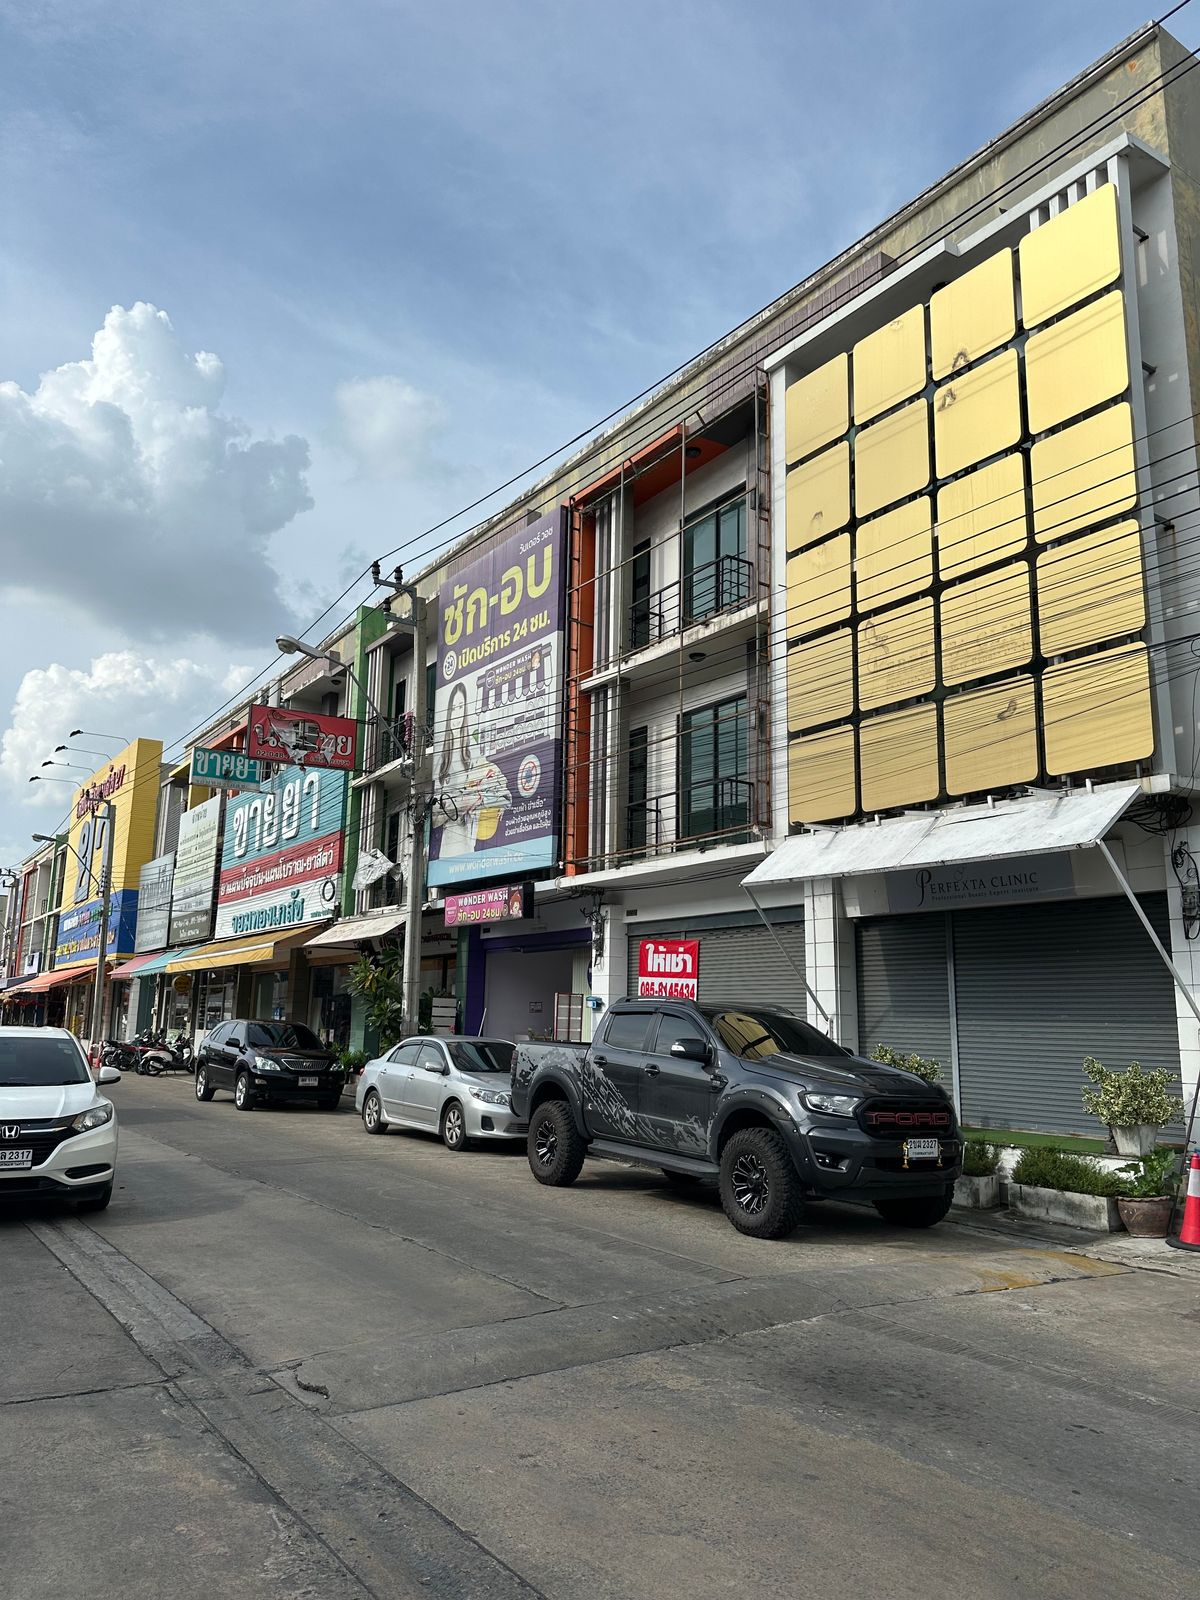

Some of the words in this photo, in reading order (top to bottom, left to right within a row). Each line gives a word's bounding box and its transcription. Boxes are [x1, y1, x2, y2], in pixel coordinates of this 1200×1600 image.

[444, 543, 553, 646] ซัก-อบ
[458, 630, 511, 670] เปิดบริการ
[513, 617, 528, 642] 24
[530, 610, 551, 633] ชม.
[495, 660, 516, 675] WONDER
[516, 652, 532, 665] WASH
[195, 750, 260, 781] ขายยา
[233, 771, 321, 859] ขายยา
[457, 893, 486, 907] WONDER
[487, 890, 509, 902] WASH
[915, 869, 985, 907] PERFEXTA
[990, 872, 1039, 888] CLINIC
[231, 889, 305, 934] จอมทองเภสัช
[457, 909, 481, 922] ซัก-อบ
[645, 943, 693, 973] ให้เช่า
[863, 1112, 950, 1125] FORD
[7, 1150, 31, 1159] 2317
[922, 1139, 936, 1148] 2327
